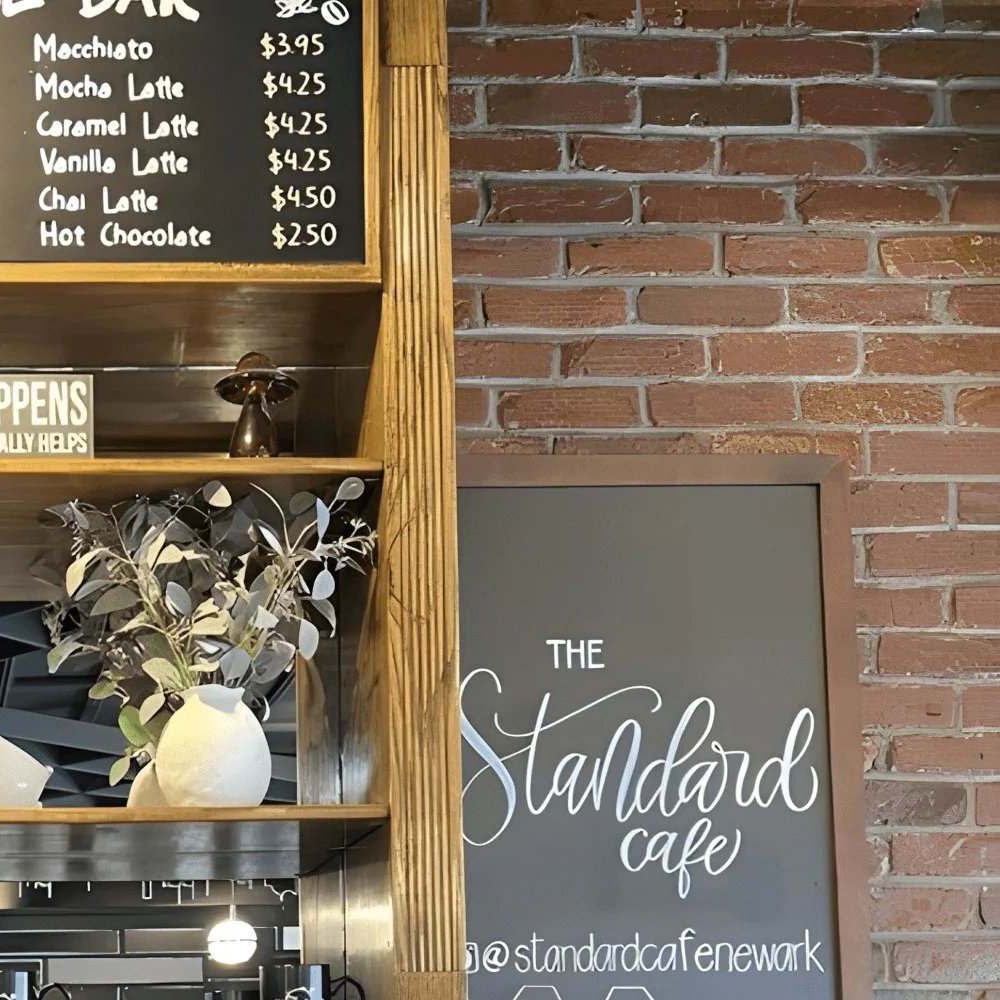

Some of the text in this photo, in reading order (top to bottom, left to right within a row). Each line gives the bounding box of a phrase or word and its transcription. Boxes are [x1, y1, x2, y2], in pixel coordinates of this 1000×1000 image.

[33, 33, 153, 62] Macchiato
[34, 72, 112, 101] Mocha
[128, 73, 184, 101] Latte
[36, 111, 127, 137] Caramel
[143, 112, 199, 139] Latte
[40, 148, 116, 175] Vanilla
[132, 148, 188, 176] Latte
[38, 186, 85, 211] Chai
[102, 187, 158, 214] Latte
[40, 221, 85, 247] Hot
[100, 222, 211, 247] Chocolate
[546, 639, 605, 669] THE
[459, 668, 819, 846] Standard
[619, 818, 742, 899] cafe
[482, 928, 825, 973] @standardcafenewark
